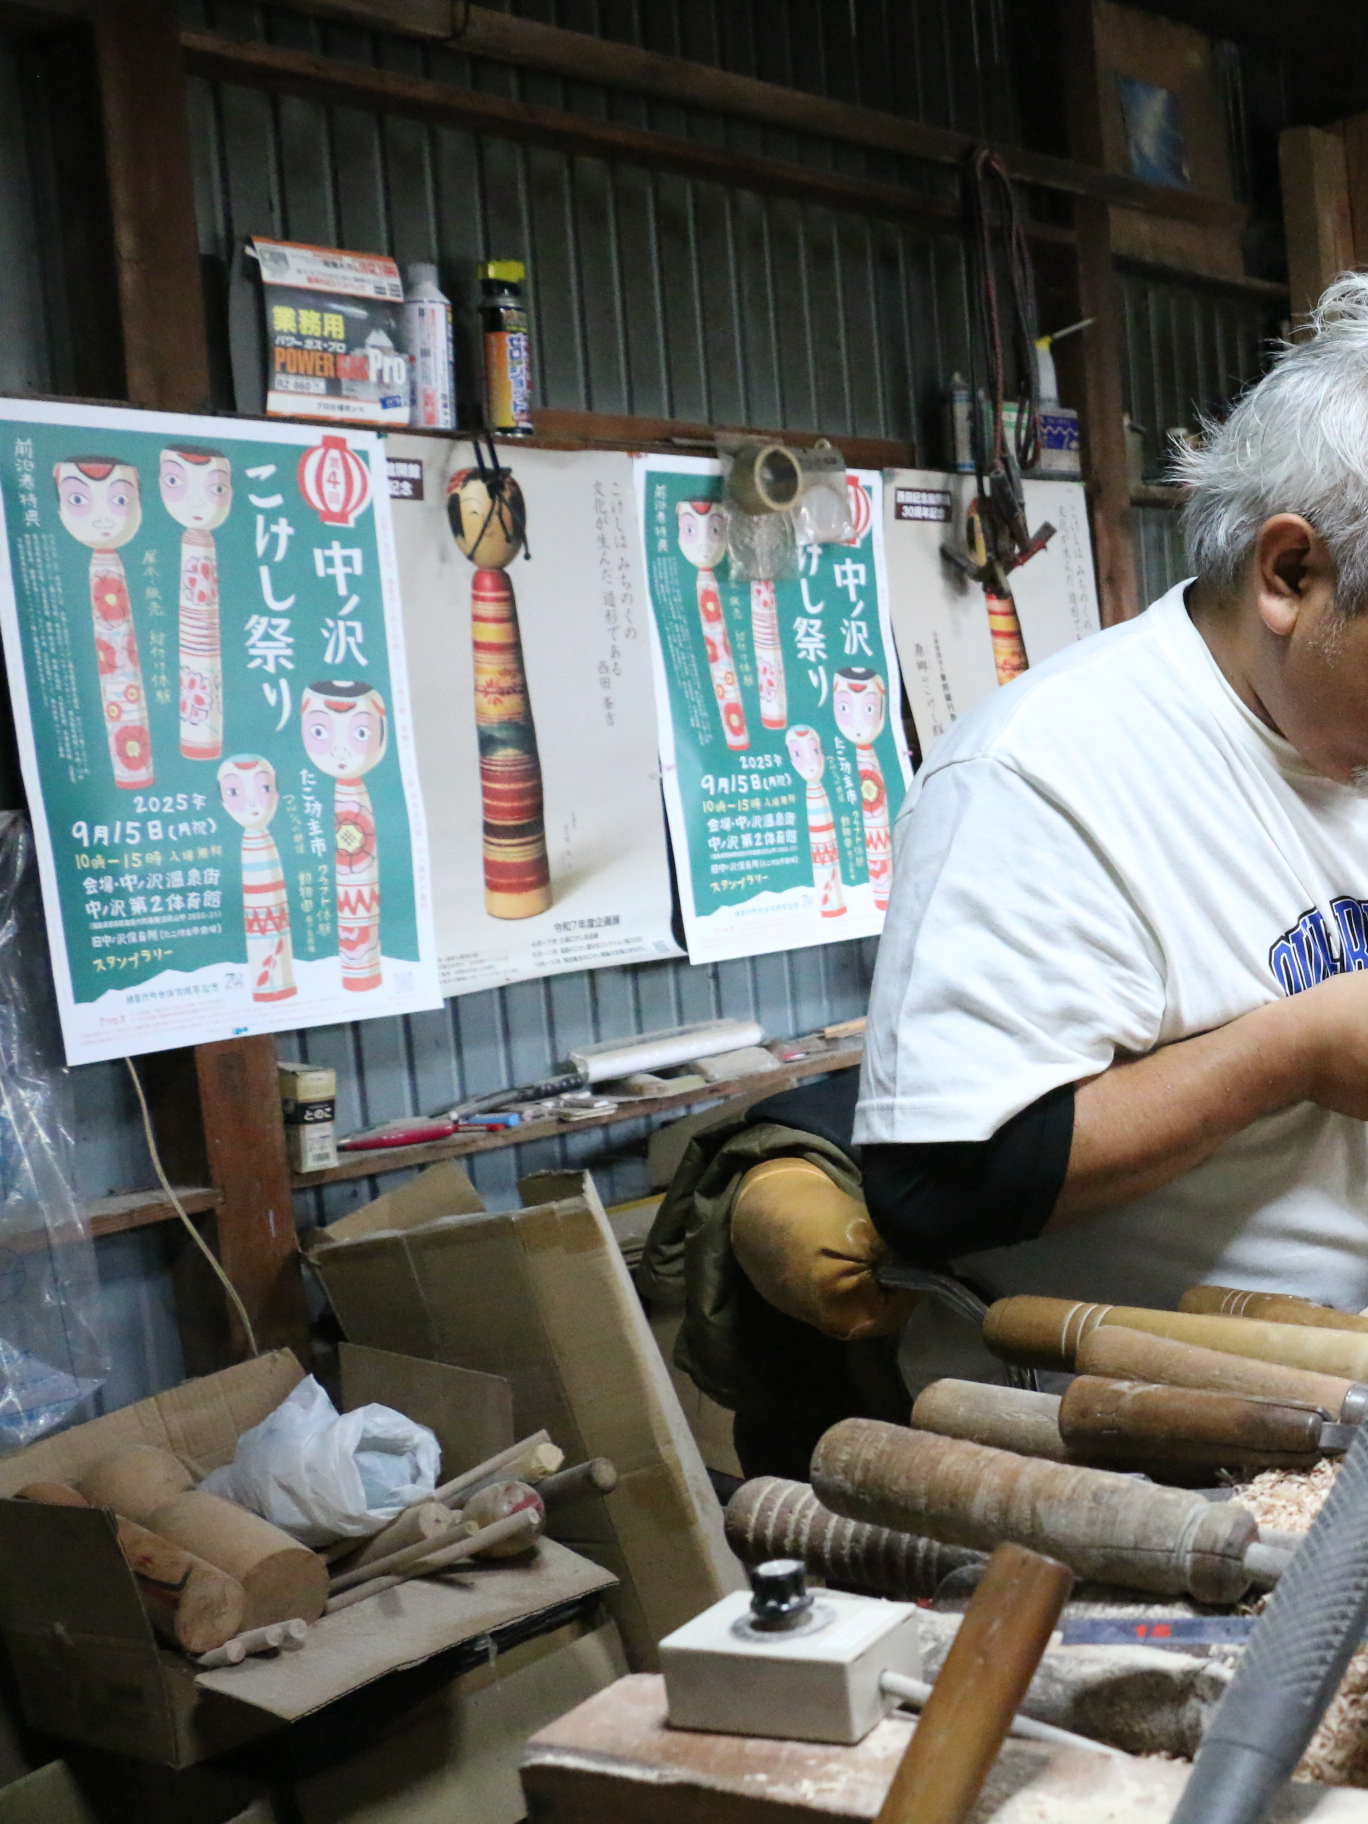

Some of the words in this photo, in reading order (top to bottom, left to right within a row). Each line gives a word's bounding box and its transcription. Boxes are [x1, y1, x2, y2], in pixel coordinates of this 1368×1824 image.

[272, 305, 345, 340] 業務用
[274, 346, 336, 379] POWER
[368, 348, 407, 385] Pro
[244, 464, 296, 732] こけし祭り
[314, 540, 369, 667] 中ノ沢
[792, 541, 829, 707] けし祭り
[833, 558, 873, 658] 中ノ沢
[739, 753, 783, 770] 2025年
[133, 792, 207, 814] 2025年
[300, 768, 327, 857] たこ坊主市
[303, 1106, 332, 1121] とのこ
